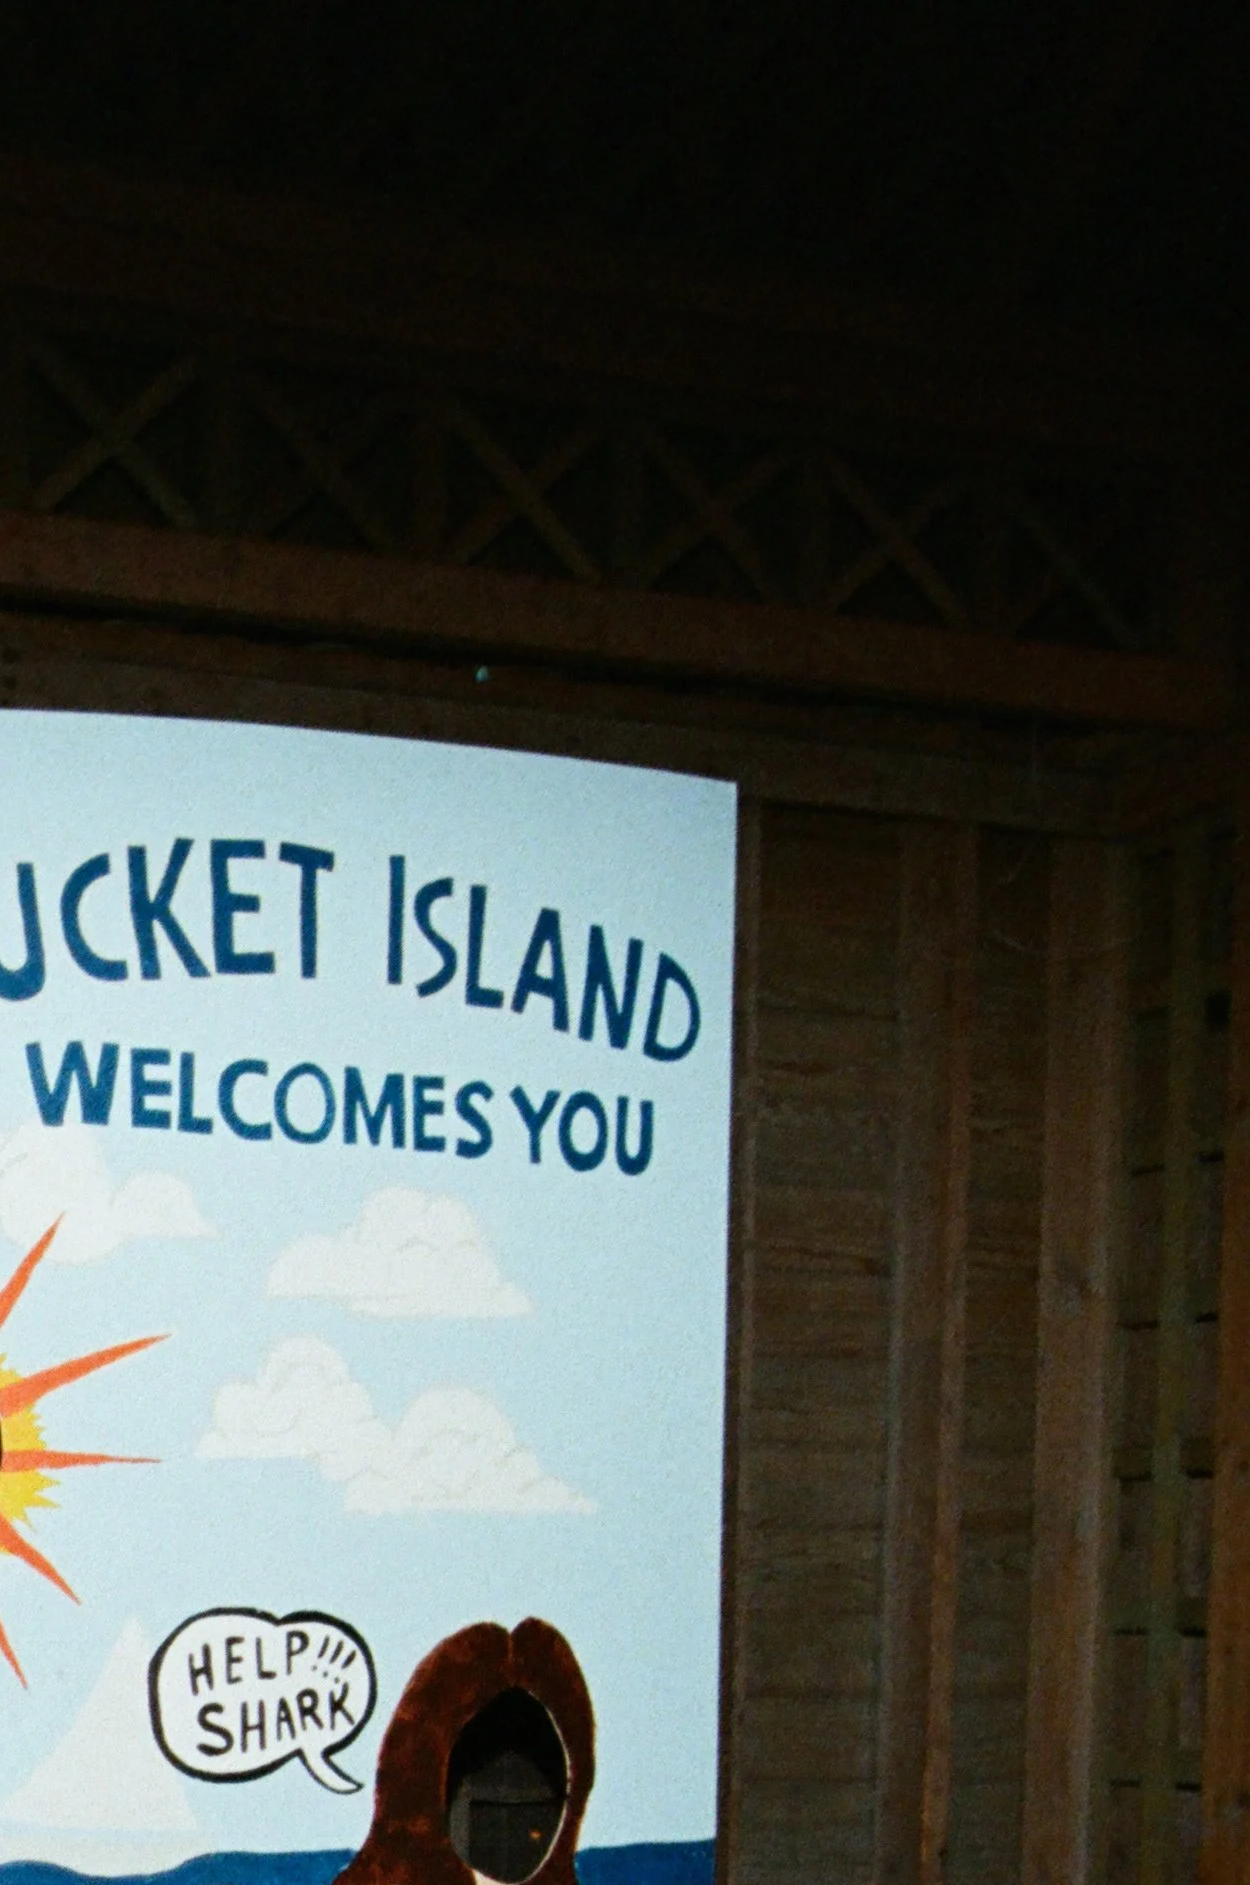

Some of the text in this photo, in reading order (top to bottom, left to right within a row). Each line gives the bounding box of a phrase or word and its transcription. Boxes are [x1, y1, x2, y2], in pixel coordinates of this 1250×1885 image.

[387, 854, 702, 1064] ISLAND
[25, 1040, 656, 1177] WELCOMES YOU
[187, 1629, 357, 1696] HELP!!!
[196, 1682, 356, 1757] SHARK
